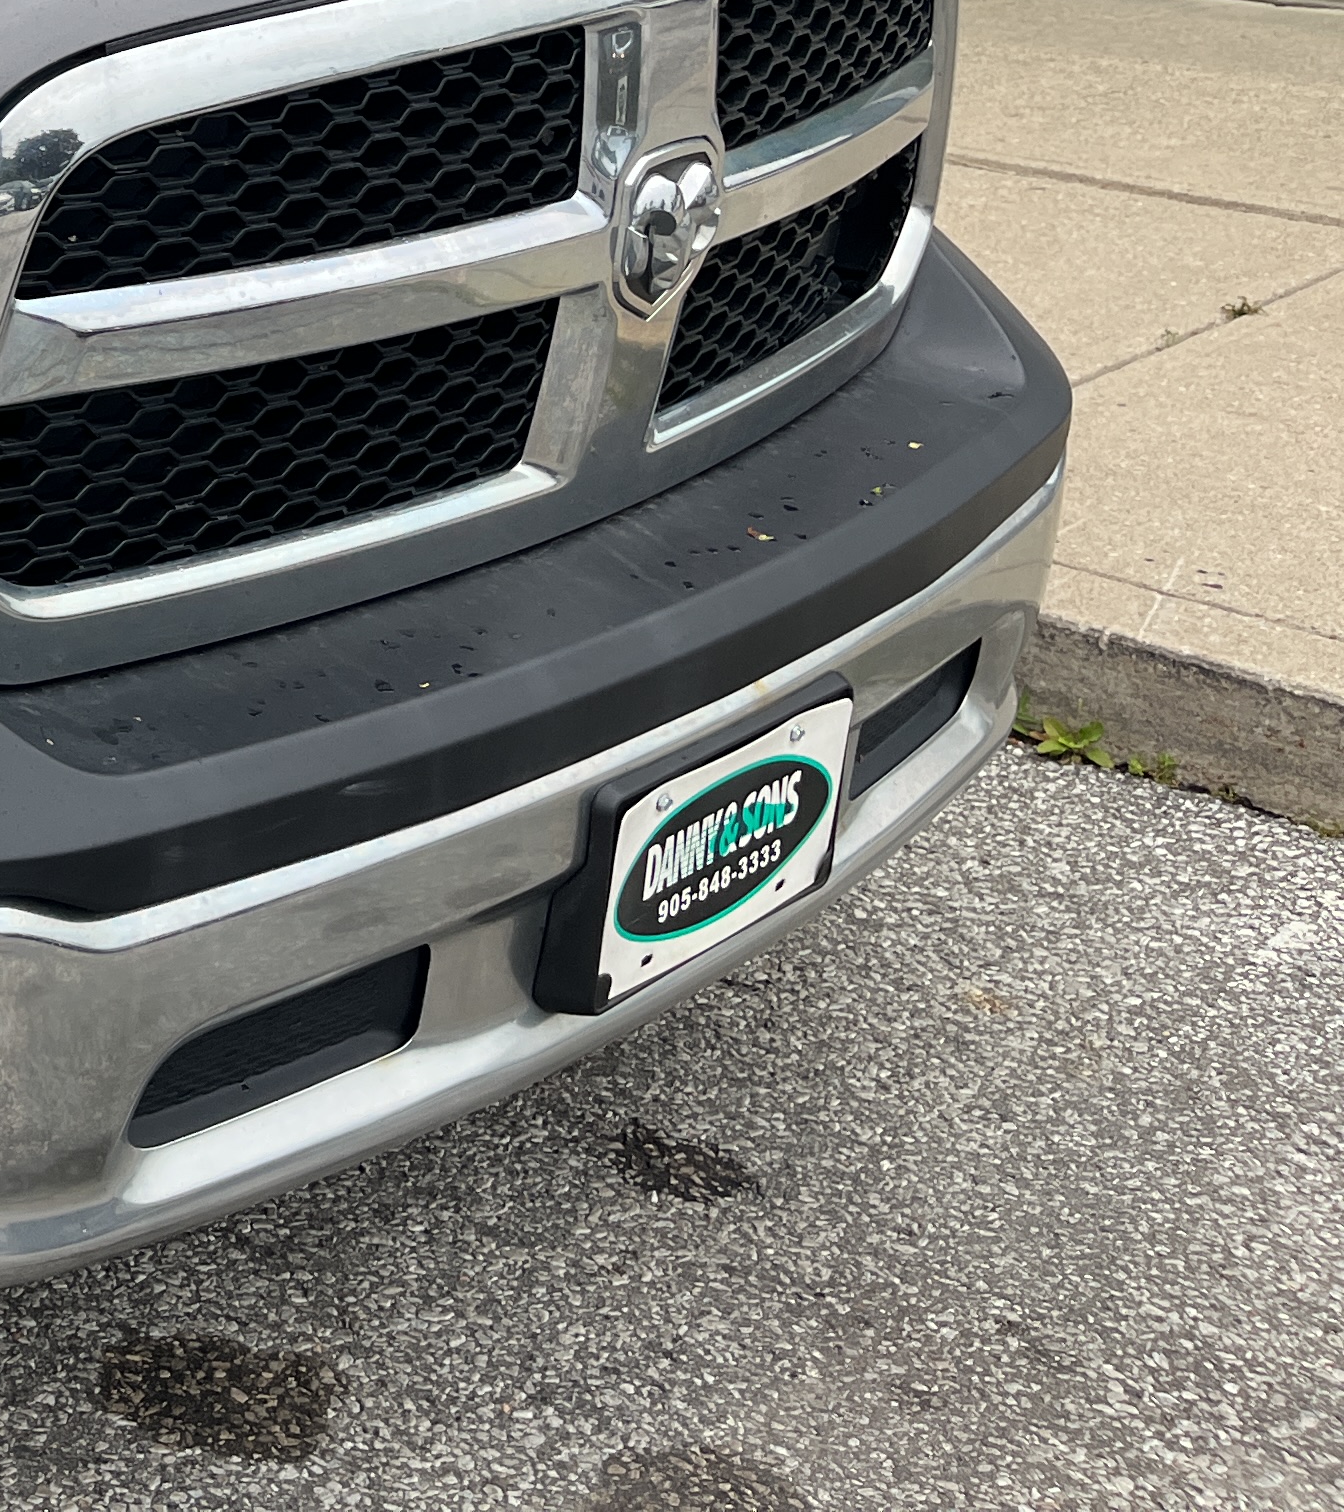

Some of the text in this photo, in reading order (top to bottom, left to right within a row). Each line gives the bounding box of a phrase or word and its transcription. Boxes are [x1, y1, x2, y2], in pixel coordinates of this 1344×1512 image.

[642, 808, 724, 901] DANNY
[739, 770, 802, 848] SONS
[657, 839, 781, 923] 905-848-3333
